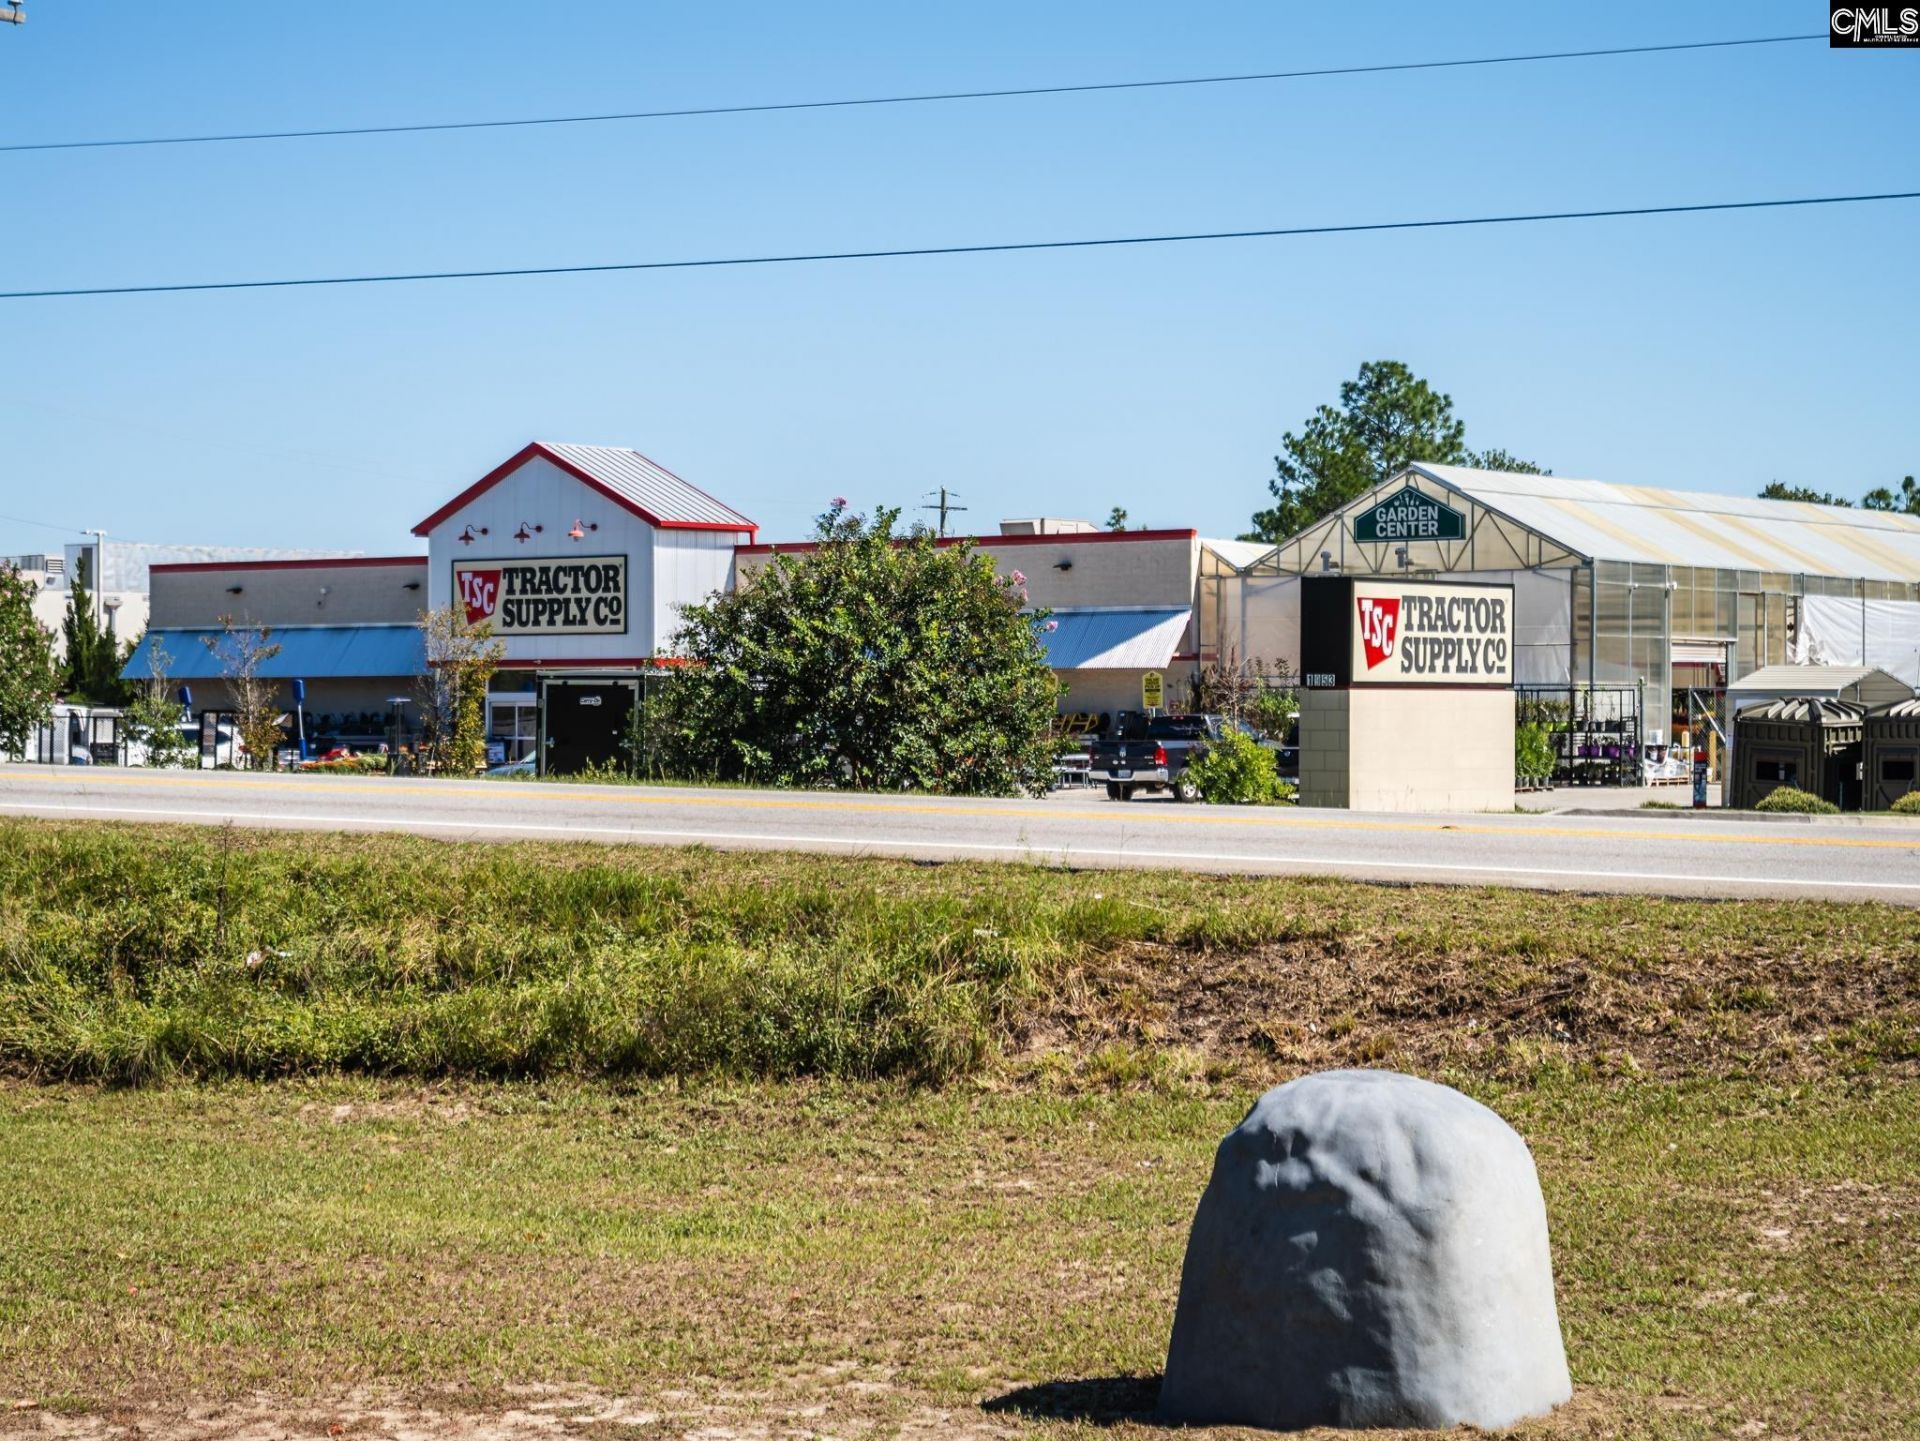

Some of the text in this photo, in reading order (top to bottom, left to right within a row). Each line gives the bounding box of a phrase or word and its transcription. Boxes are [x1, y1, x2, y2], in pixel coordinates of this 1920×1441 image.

[1375, 506, 1438, 521] GARDEN
[1375, 521, 1439, 537] CENTER
[461, 572, 494, 615] TSC
[502, 564, 621, 596] TRACTOR
[502, 597, 592, 627] SUPPLY
[1361, 599, 1394, 656] TSC
[1401, 595, 1506, 634] TRACTOR
[1401, 636, 1481, 674] SUPPLY
